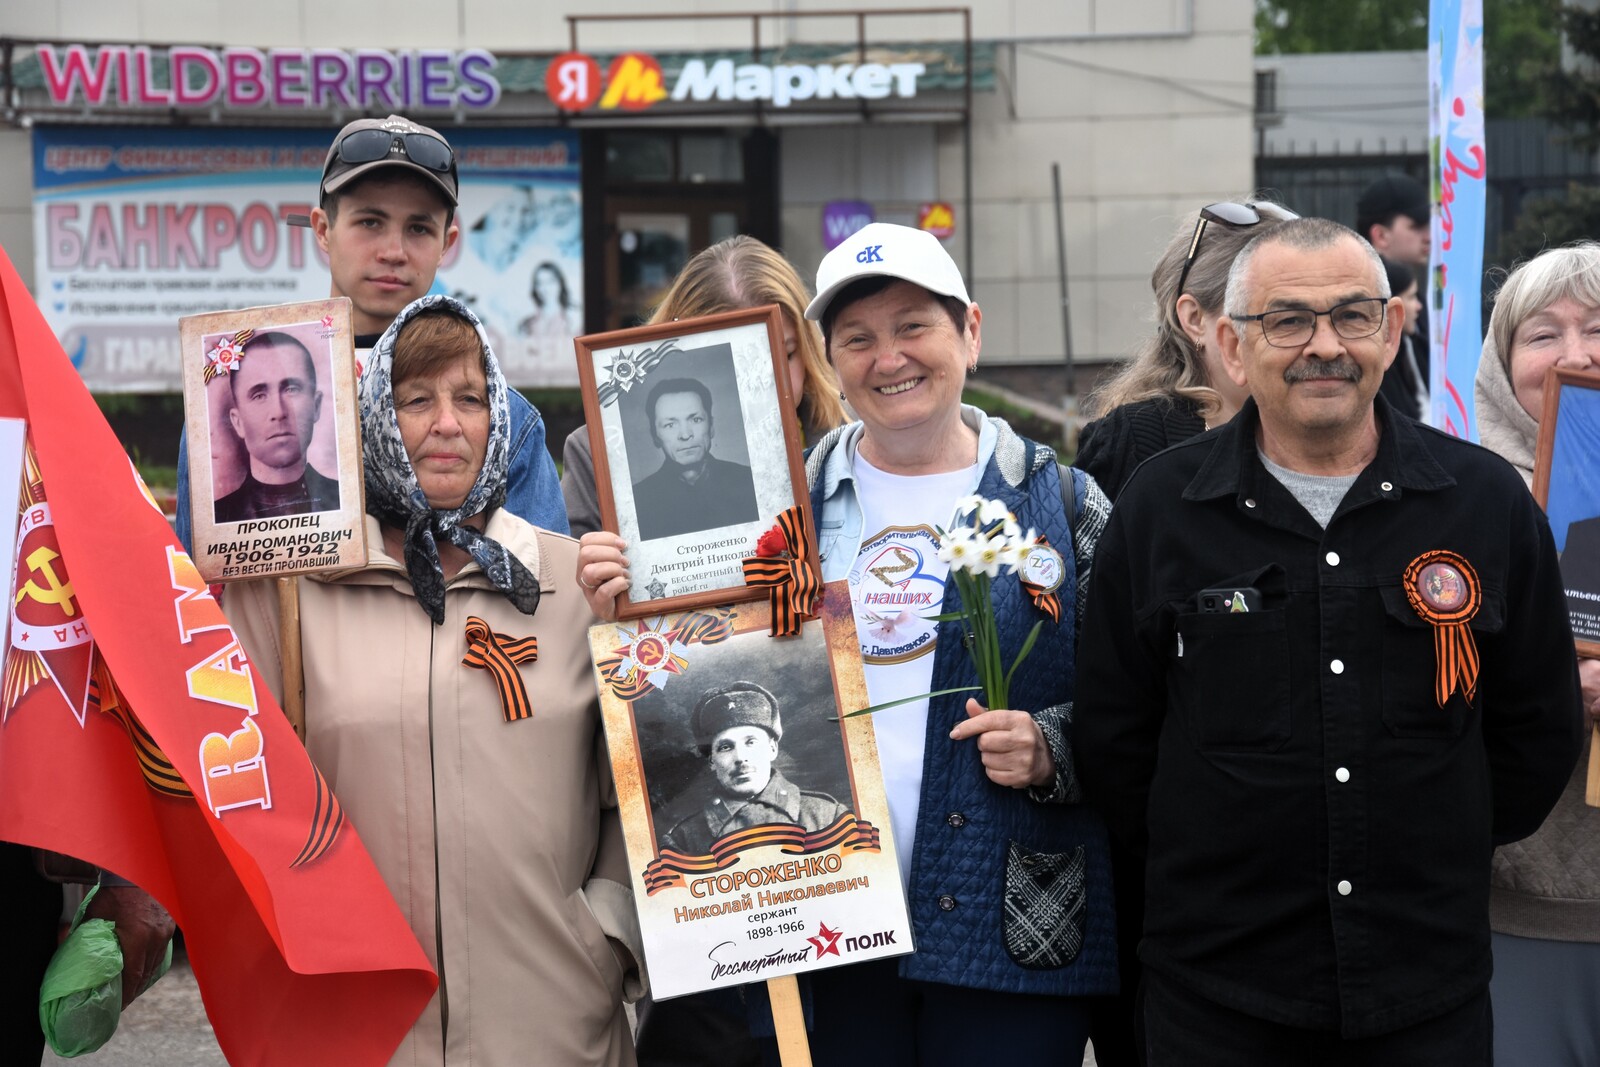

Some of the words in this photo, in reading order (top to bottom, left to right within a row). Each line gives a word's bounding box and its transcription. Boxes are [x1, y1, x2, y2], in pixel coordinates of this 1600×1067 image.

[36, 46, 501, 108] WILDBERRIES
[671, 59, 926, 106] Маркет
[237, 515, 320, 534] ПРОКОПЕЦ
[207, 540, 249, 556] ИВАН
[252, 529, 353, 550] РОМАНОВИЧ
[223, 542, 339, 566] 1906-1942
[676, 536, 748, 556] Стороженко
[222, 567, 240, 577] БЕЗ
[241, 564, 273, 575] ВЕСТИ
[274, 554, 340, 572] ПРОПАВШИЙ
[650, 557, 705, 576] Дмитрий
[707, 549, 757, 568] Николае
[671, 567, 734, 585] БЕССМЕРТНЫЙ
[672, 583, 709, 597] polkrf.ru
[864, 592, 933, 605] наших
[871, 632, 931, 657] Давлеканово
[690, 853, 842, 899] СТОРОЖЕНКО
[674, 892, 753, 923] Николай
[757, 875, 870, 909] Николаевич
[747, 906, 798, 924] сержант
[746, 919, 805, 941] 1898-1966
[845, 929, 897, 953] ПОЛК
